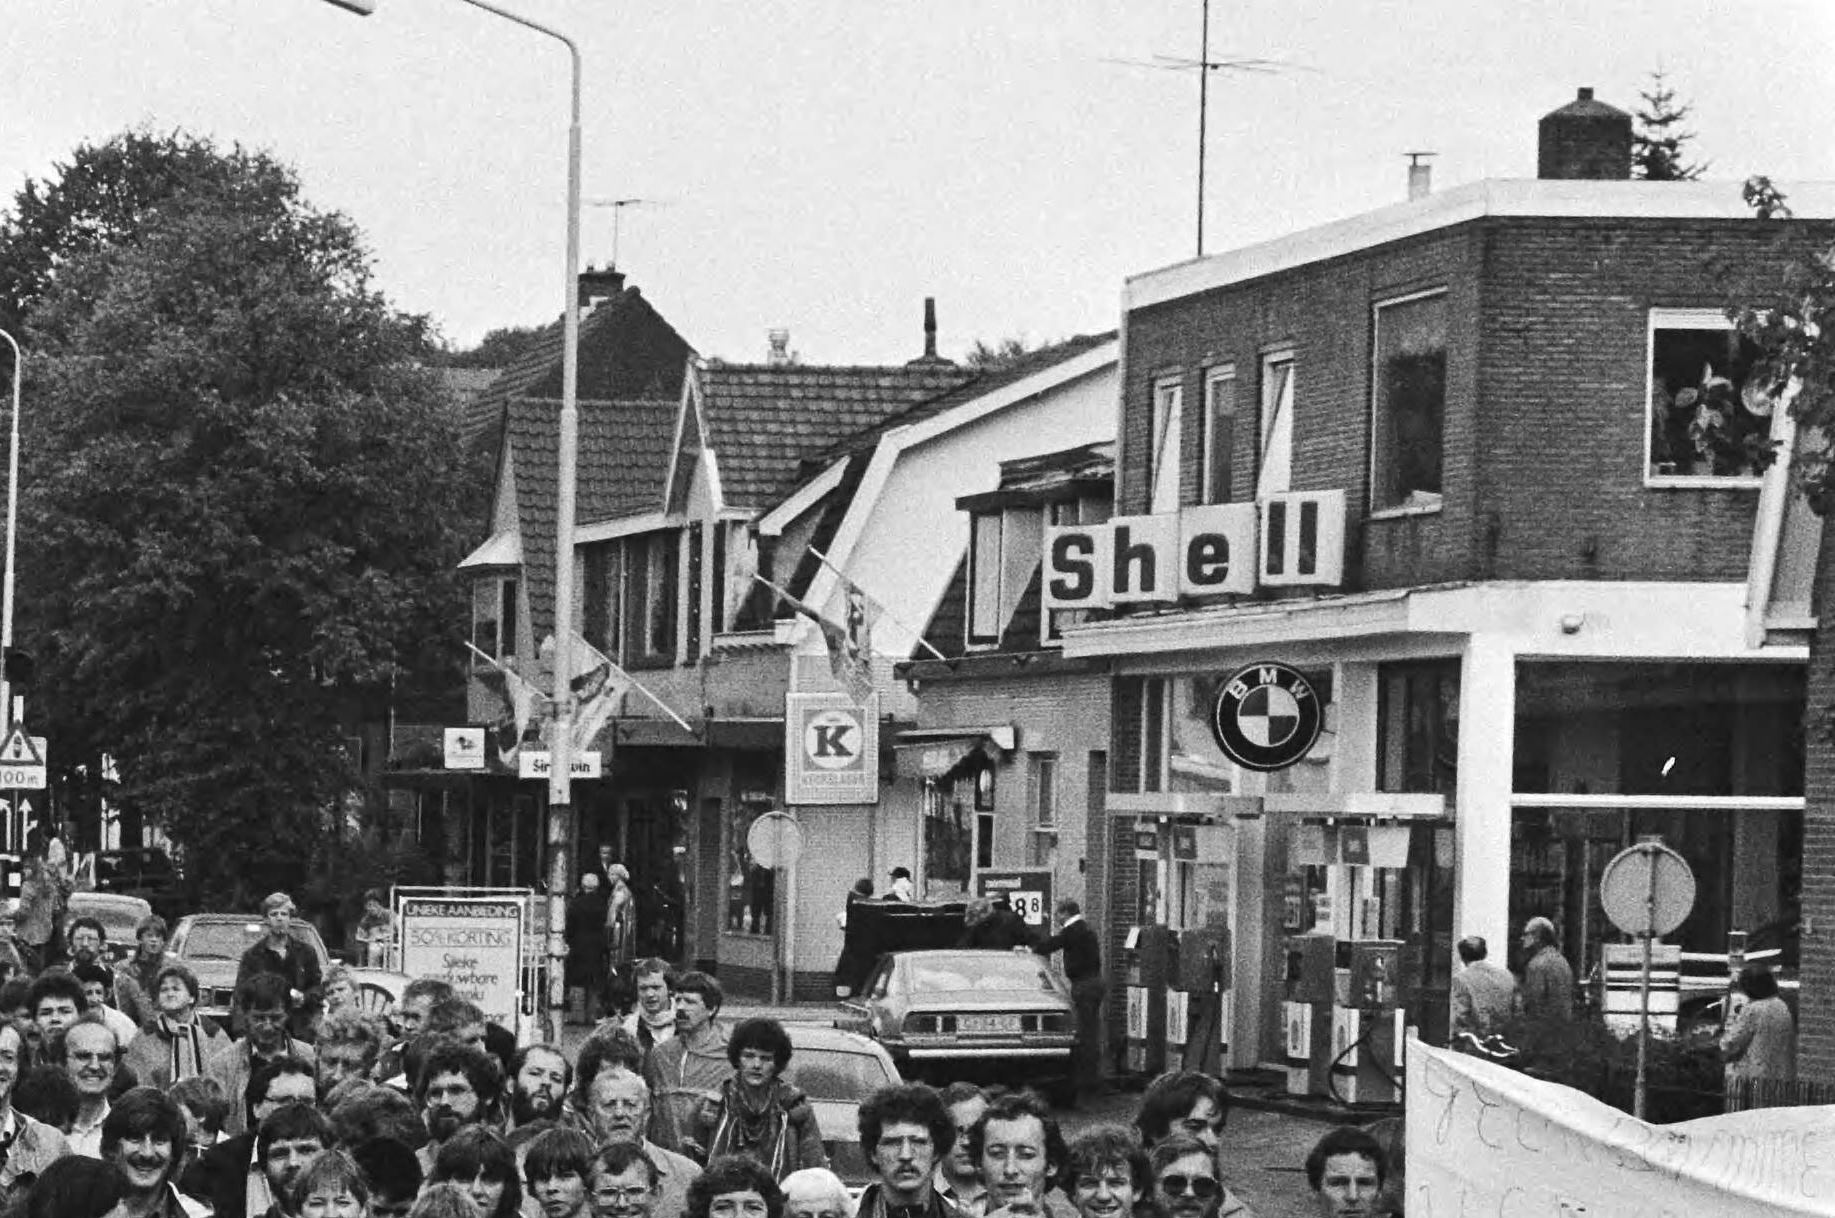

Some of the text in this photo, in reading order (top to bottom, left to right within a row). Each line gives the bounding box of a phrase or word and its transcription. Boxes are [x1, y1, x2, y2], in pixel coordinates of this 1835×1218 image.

[1050, 502, 1318, 601] Shell
[1227, 667, 1311, 700] BMW
[813, 725, 855, 758] K
[446, 928, 511, 945] KORTING
